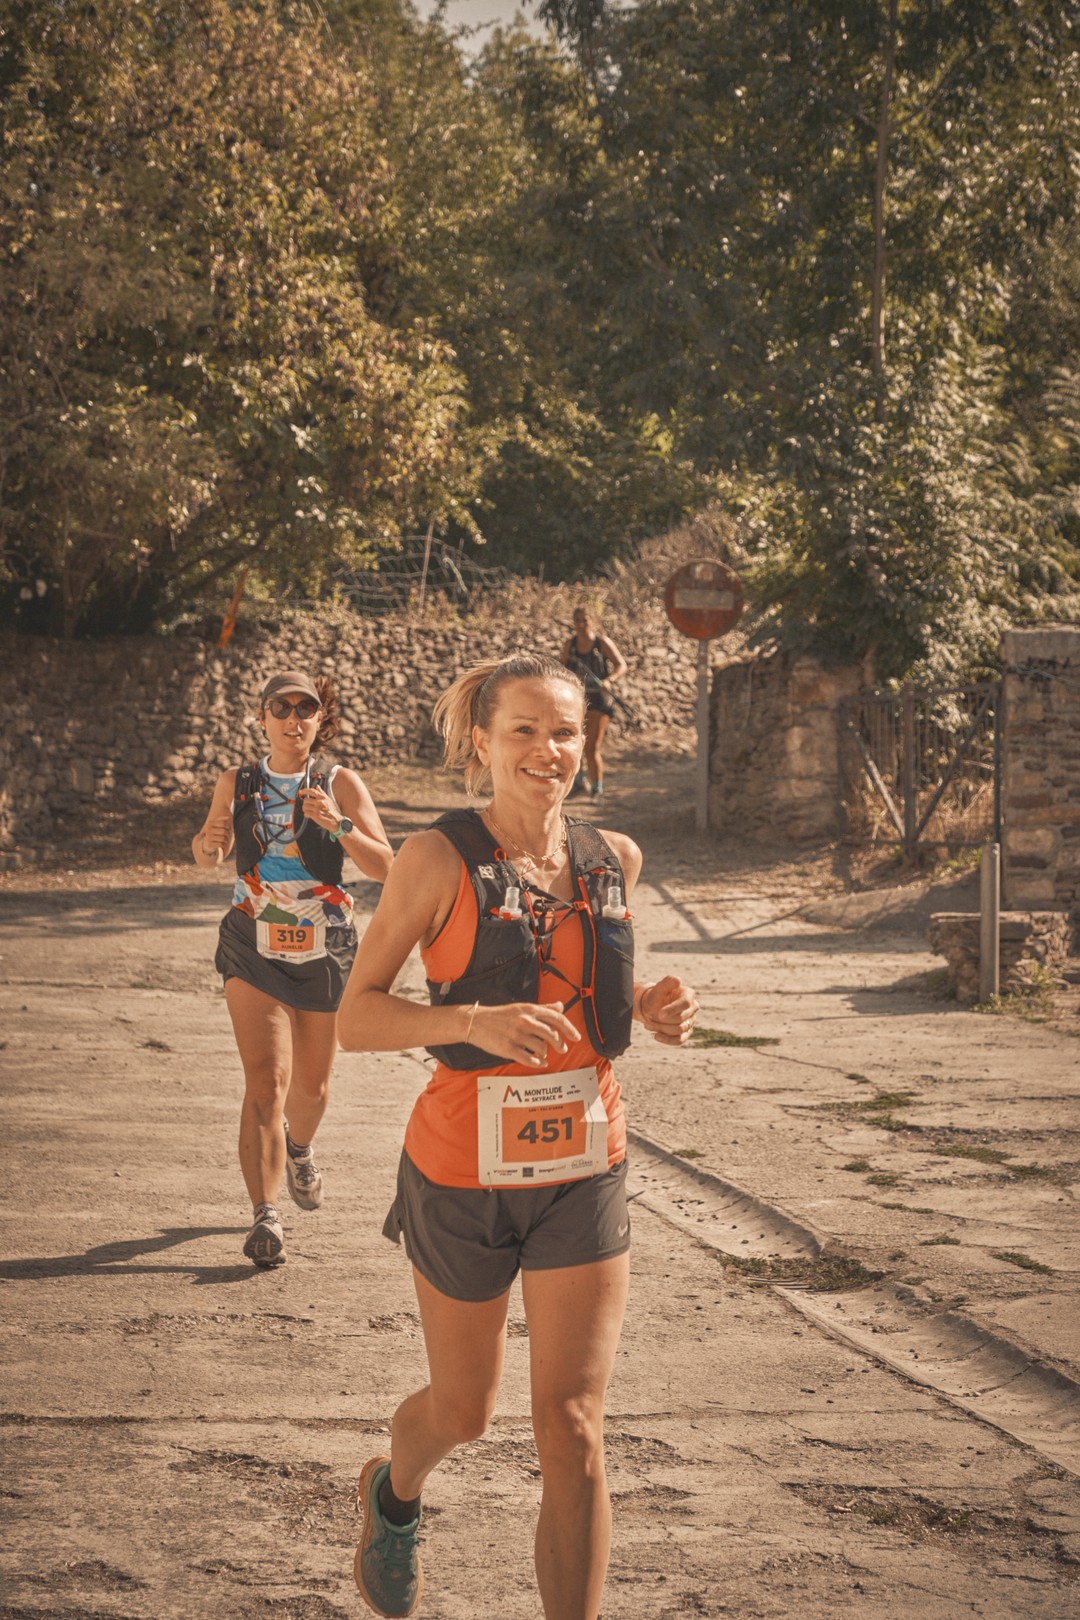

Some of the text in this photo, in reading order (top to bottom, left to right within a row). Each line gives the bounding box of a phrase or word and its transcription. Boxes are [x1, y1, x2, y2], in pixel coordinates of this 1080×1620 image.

[277, 929, 306, 943] 319
[524, 1086, 563, 1096] MONTLUDE
[531, 1094, 556, 1102] SKYRACE
[517, 1117, 572, 1144] 451
